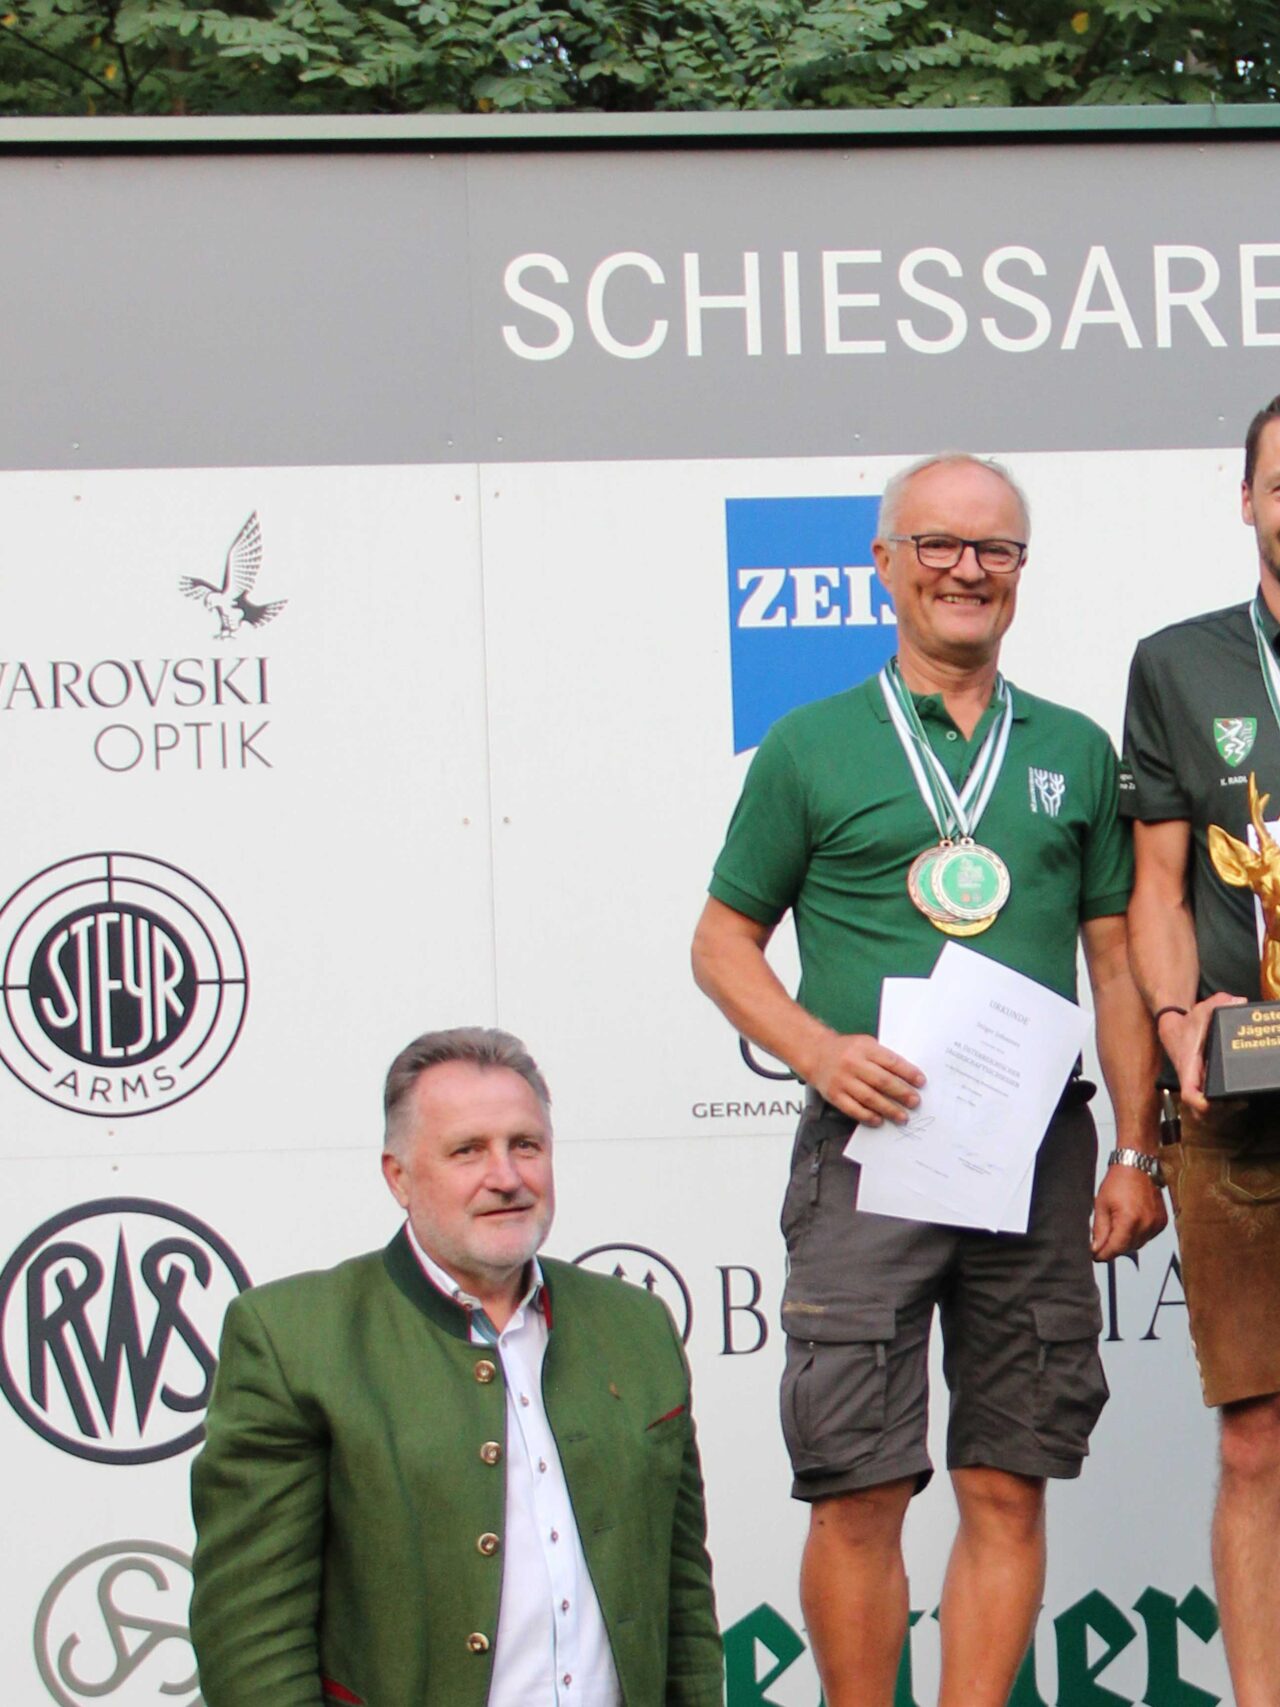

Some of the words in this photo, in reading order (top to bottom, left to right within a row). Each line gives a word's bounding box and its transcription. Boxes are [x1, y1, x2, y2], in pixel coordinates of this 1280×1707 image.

[93, 720, 273, 773] OPTIK
[40, 911, 186, 1059] STEYR
[54, 1064, 178, 1103] ARMS
[692, 1099, 803, 1119] GERMAN
[26, 1220, 218, 1440] RWS
